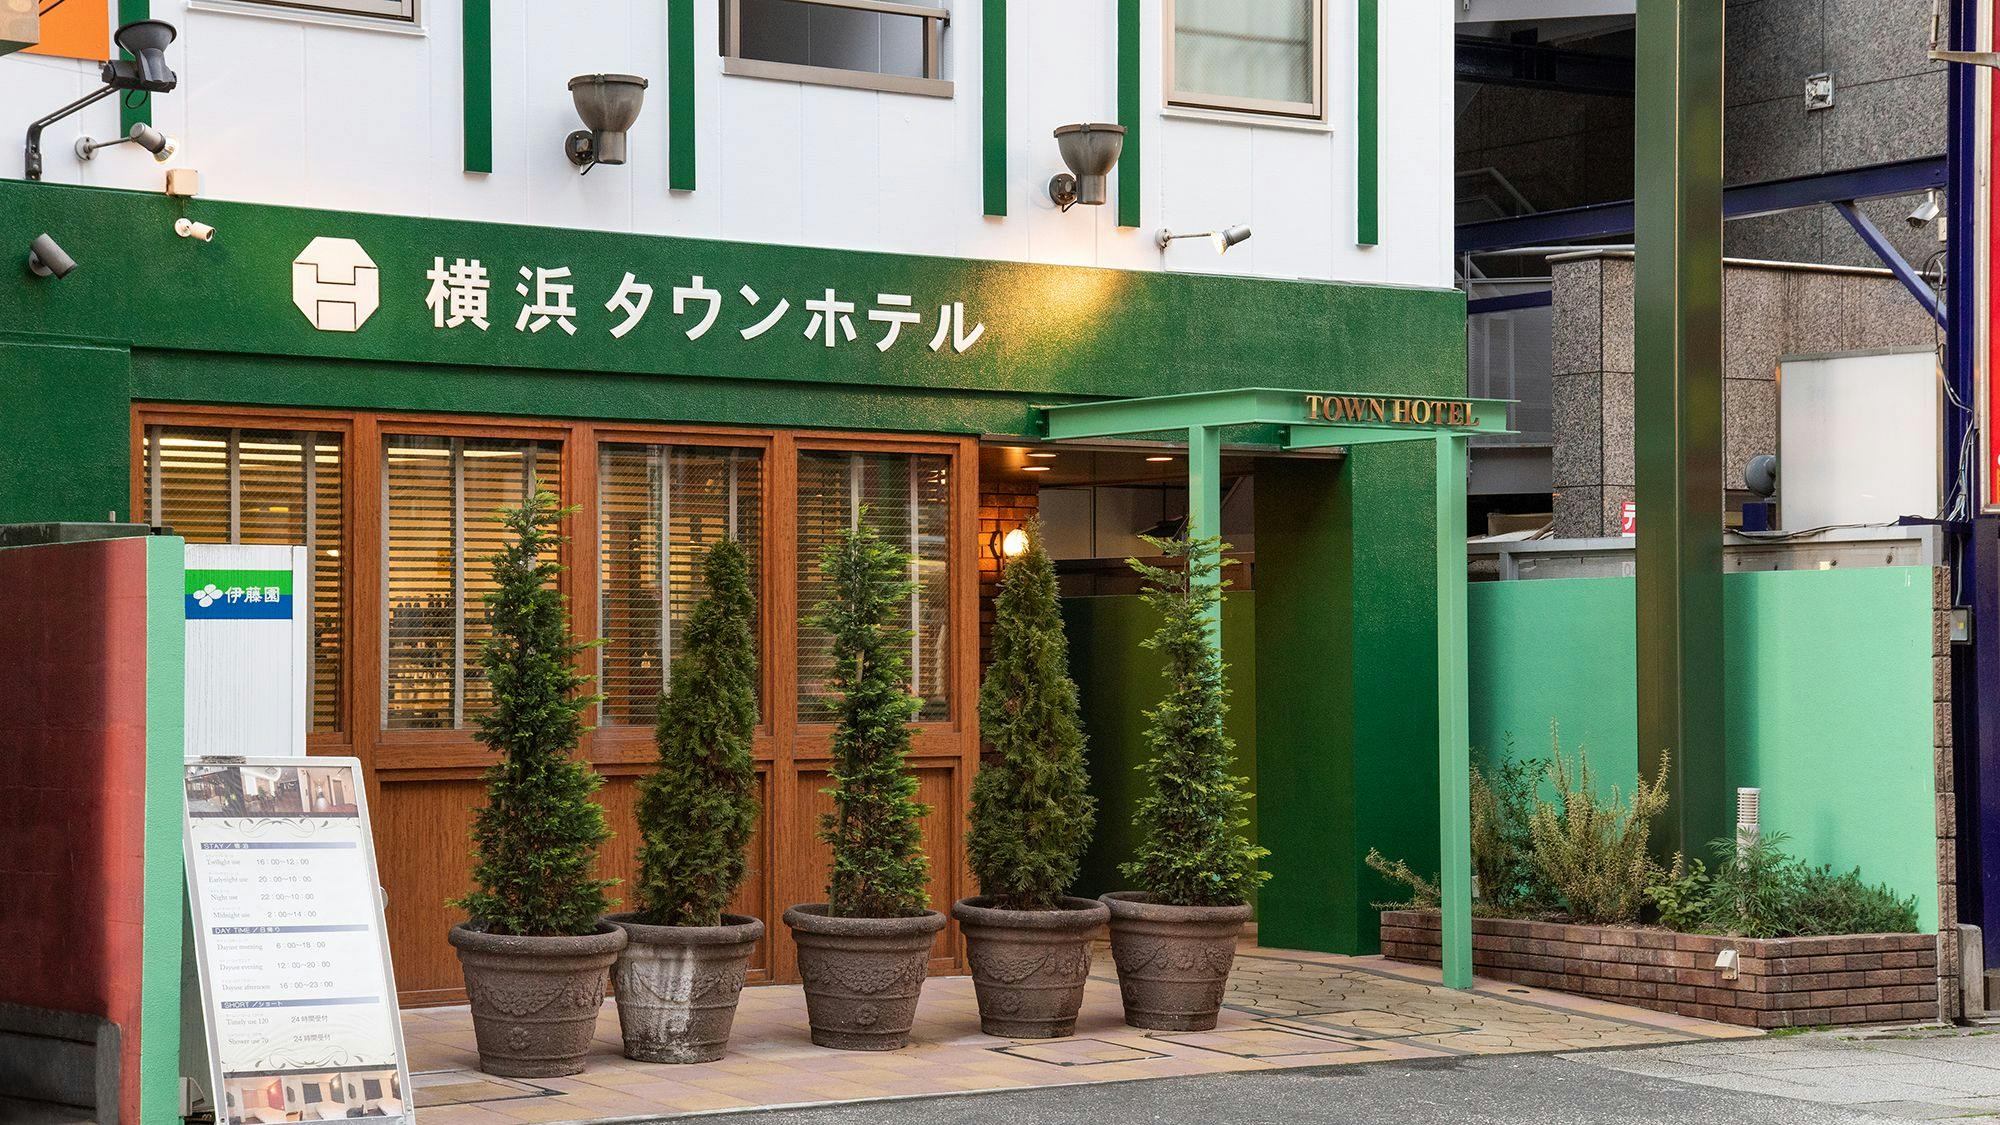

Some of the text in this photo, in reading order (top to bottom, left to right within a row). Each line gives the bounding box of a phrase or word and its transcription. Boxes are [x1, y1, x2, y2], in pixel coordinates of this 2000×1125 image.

[1306, 394, 1481, 427] TOWN HOTEL
[225, 586, 280, 604] 伊藤園
[210, 894, 228, 902] Night
[257, 1016, 269, 1024] 120
